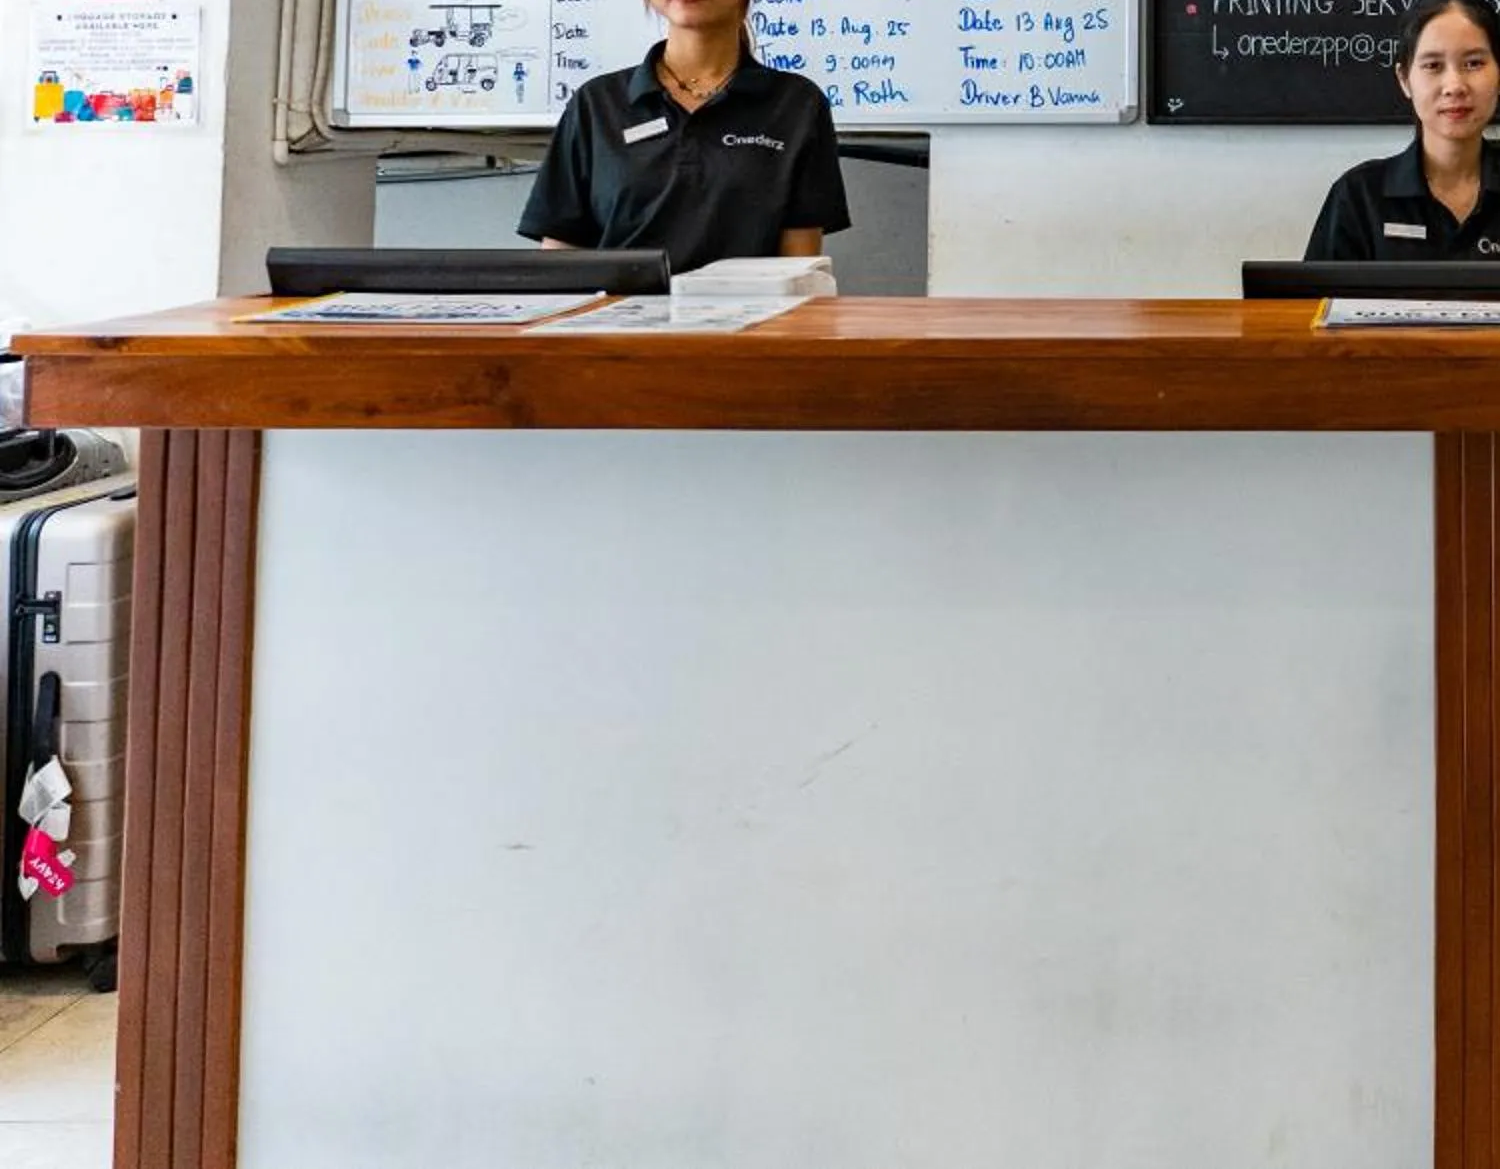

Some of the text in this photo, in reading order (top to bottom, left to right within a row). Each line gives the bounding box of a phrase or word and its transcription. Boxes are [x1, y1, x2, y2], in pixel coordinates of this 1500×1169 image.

[959, 7, 1004, 32] Date
[1082, 8, 1109, 31] 25
[960, 79, 1021, 106] Driver
[721, 133, 785, 151] Onederz
[29, 856, 66, 892] HEAVY
